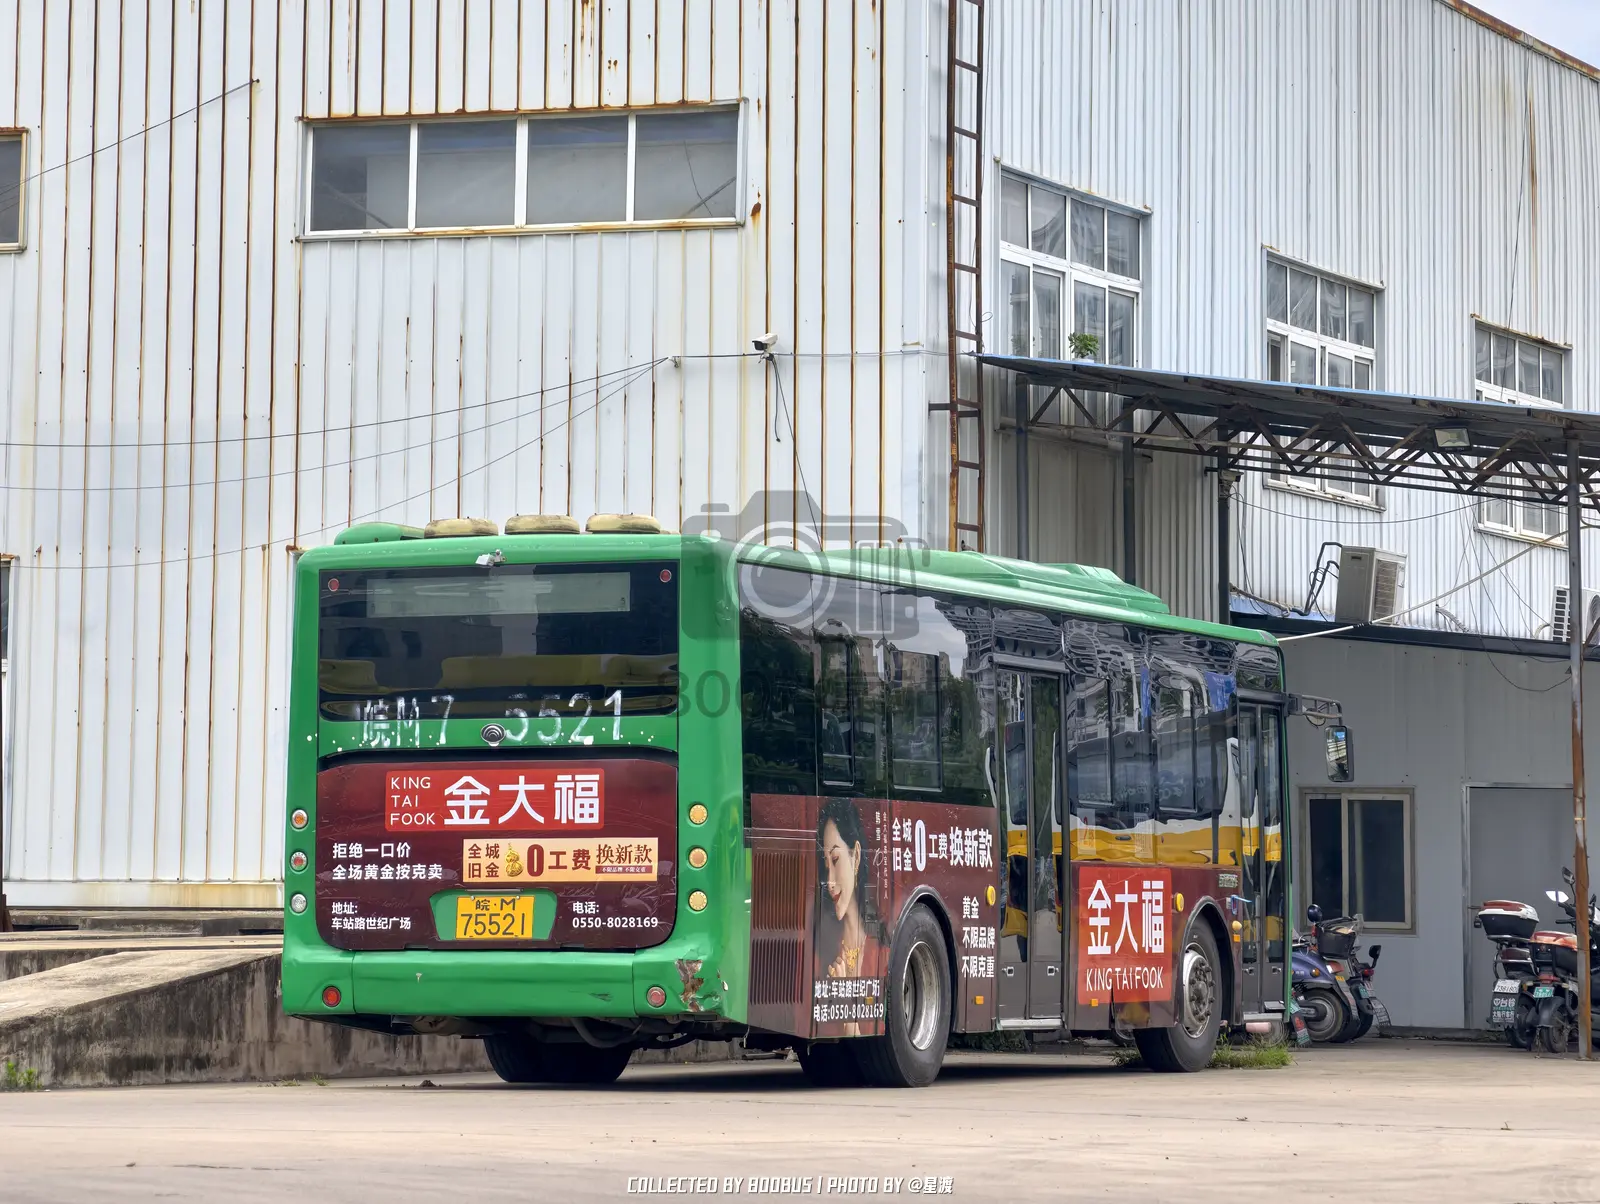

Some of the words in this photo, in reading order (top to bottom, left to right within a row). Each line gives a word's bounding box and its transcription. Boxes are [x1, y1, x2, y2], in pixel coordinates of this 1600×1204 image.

[391, 777, 431, 789] KING
[391, 795, 418, 807] TAI
[444, 775, 600, 825] 金大福
[390, 813, 435, 826] FOOK
[892, 817, 912, 842] 全城
[333, 842, 411, 859] 拒绝一口价
[468, 843, 500, 859] 全城
[596, 844, 652, 865] 换新款
[949, 826, 993, 868] 换新款
[468, 862, 500, 878] 旧金
[892, 847, 913, 872] 旧金
[332, 863, 443, 880] 全场黄金按克卖
[962, 896, 979, 919] 黄金
[1087, 879, 1164, 955] 金大福
[331, 917, 411, 930] 车站路世纪广场
[461, 913, 525, 936] 75521
[572, 917, 659, 929] 0550-8028169
[962, 926, 995, 949] 不限品牌
[961, 955, 995, 978] 不限克重
[1086, 967, 1113, 992] KING
[1114, 967, 1133, 990] TAI
[1135, 966, 1164, 989] FOOK
